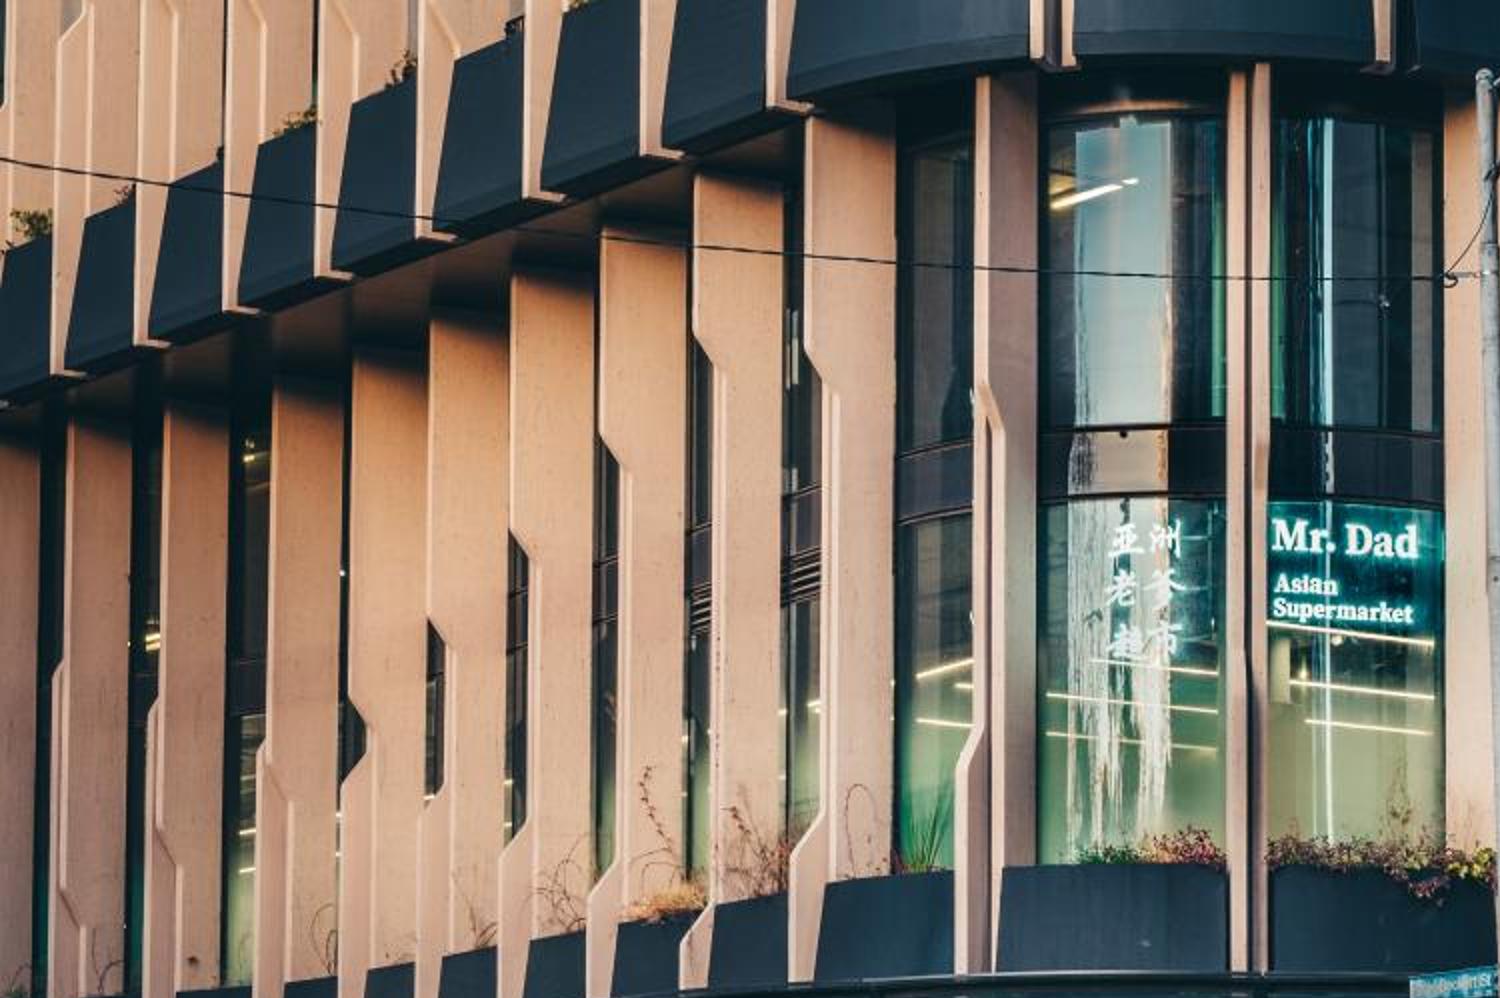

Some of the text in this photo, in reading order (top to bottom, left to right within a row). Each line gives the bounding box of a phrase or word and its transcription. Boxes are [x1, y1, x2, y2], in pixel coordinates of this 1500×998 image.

[1271, 518, 1420, 560] Mr. Dad
[1273, 573, 1339, 596] Asian
[1273, 597, 1416, 624] Supermarket
